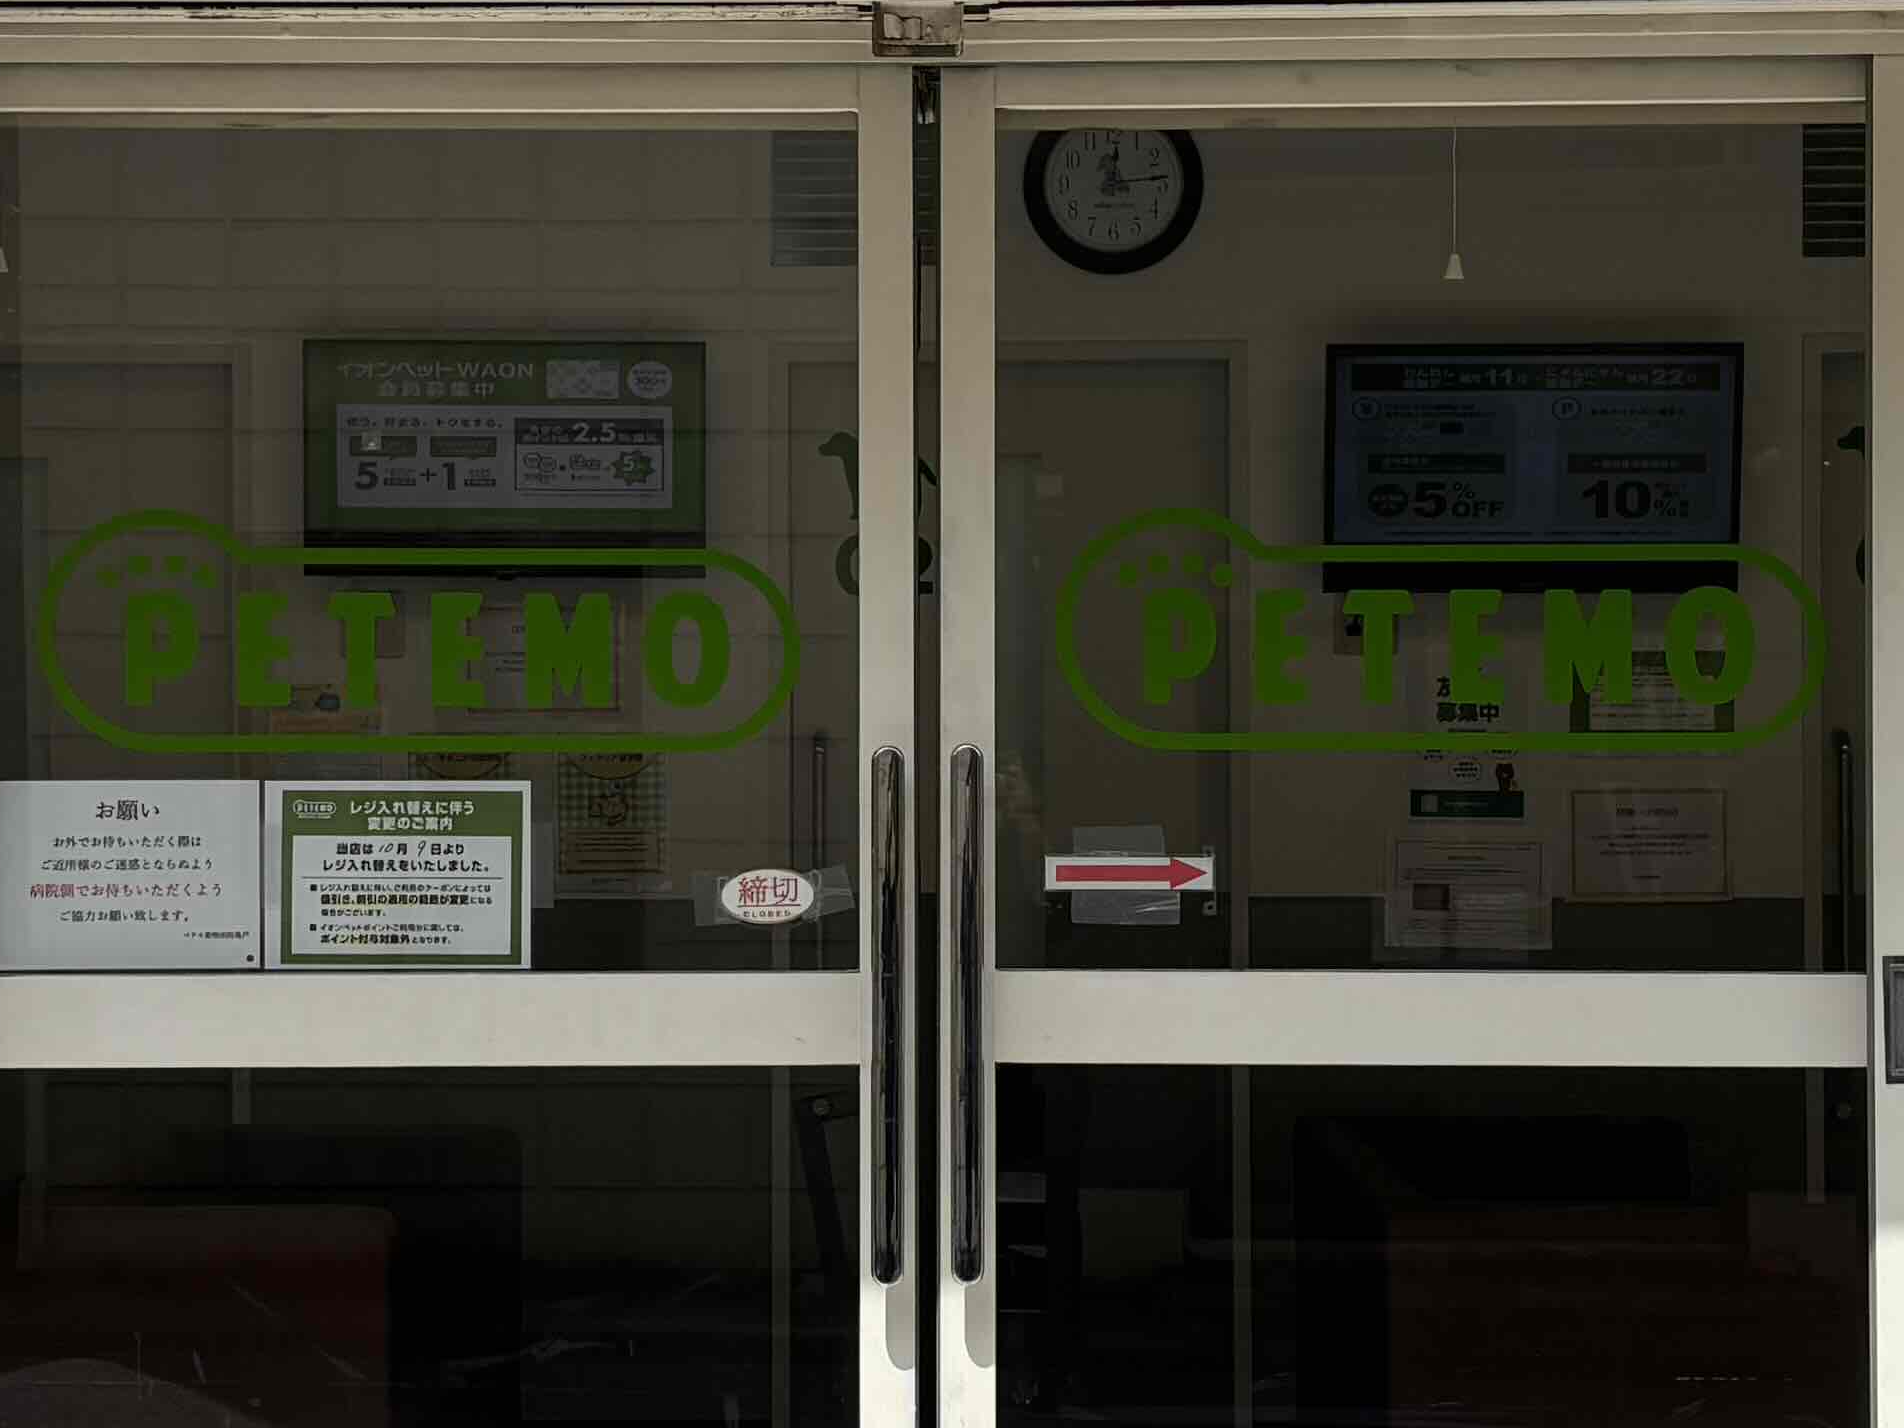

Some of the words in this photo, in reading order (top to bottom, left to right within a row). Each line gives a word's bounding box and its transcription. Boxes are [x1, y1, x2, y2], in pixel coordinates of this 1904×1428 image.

[120, 589, 732, 710] PETEMO
[1141, 584, 1757, 707] PETEMO
[95, 799, 162, 821] お願い
[349, 799, 476, 816] レジ入れ替えに伴う
[53, 835, 202, 849] お外でお待ちいただく際は
[40, 858, 214, 872] ご近所様のご迷惑とならぬよう
[322, 858, 491, 873] レジ入れ替えをいたしました。
[30, 883, 223, 899] 病院側でお待ちいただくよう
[737, 875, 800, 907] 締切
[59, 909, 190, 924] ご協力お願い致します。
